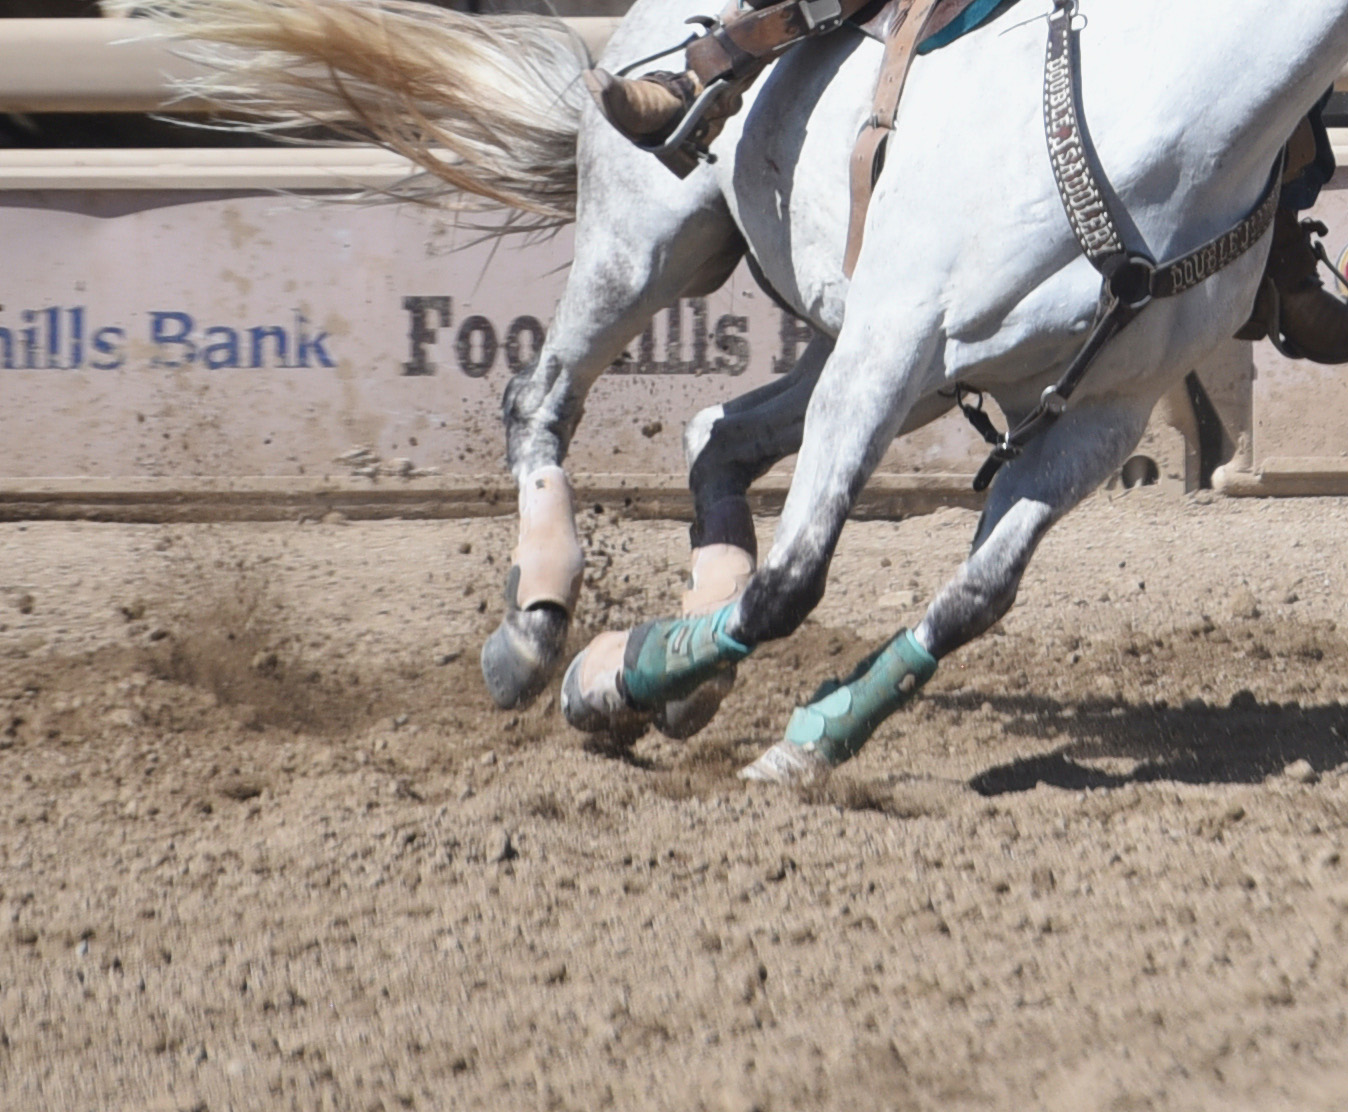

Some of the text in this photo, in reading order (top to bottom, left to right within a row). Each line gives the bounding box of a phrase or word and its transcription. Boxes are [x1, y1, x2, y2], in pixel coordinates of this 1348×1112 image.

[1048, 54, 1071, 133] DOUBLE
[1058, 148, 1118, 256] SADDLERY
[146, 310, 338, 370] Bank
